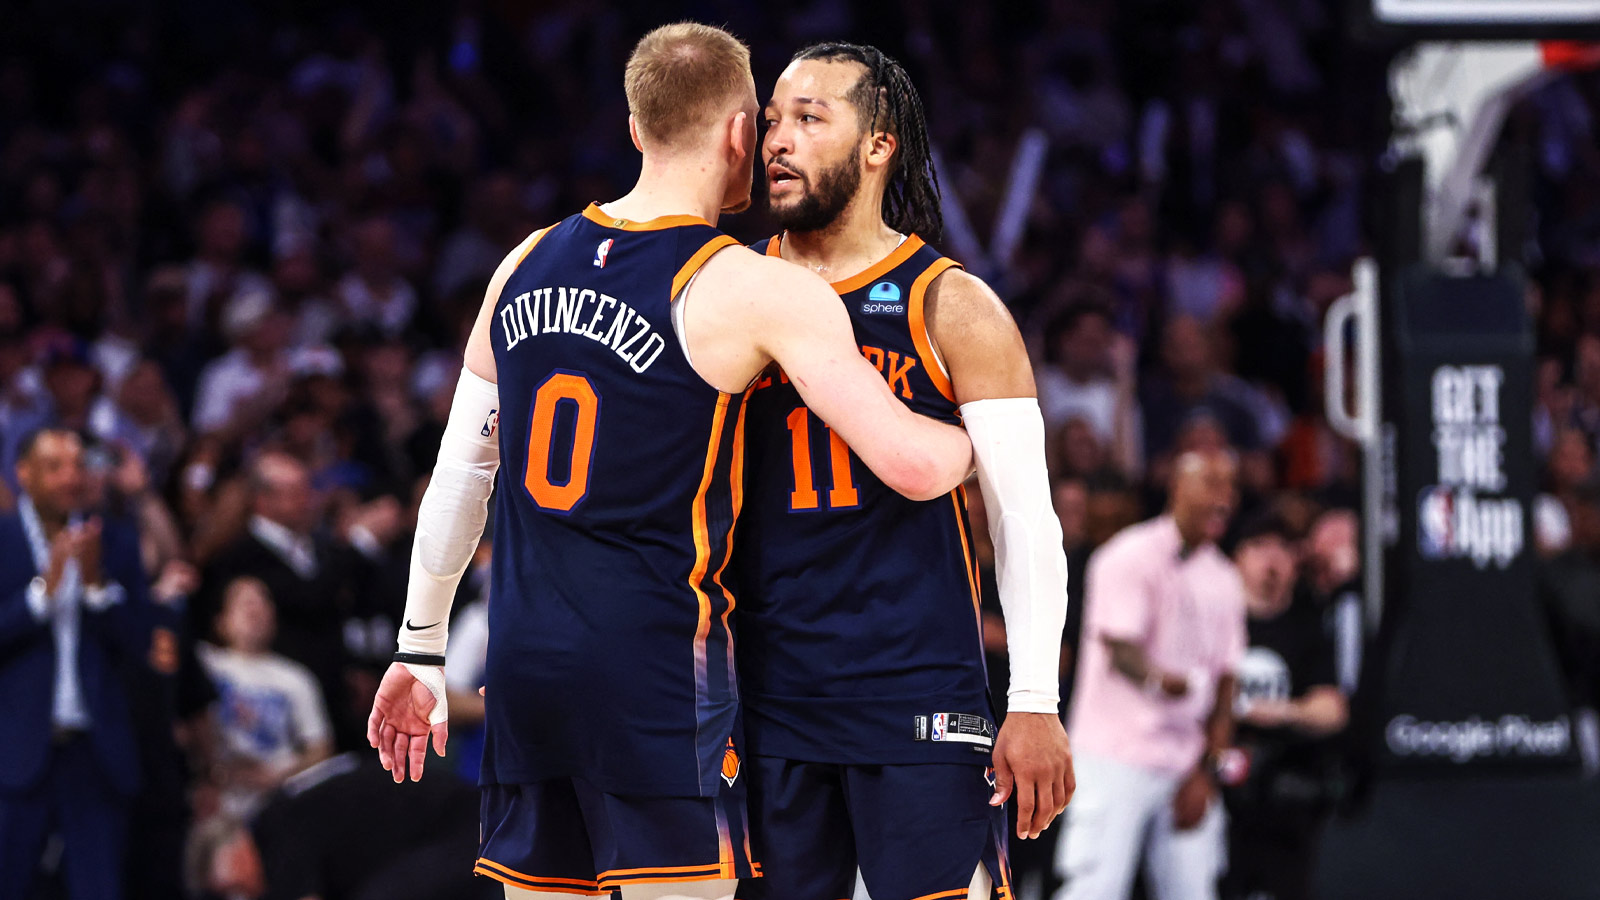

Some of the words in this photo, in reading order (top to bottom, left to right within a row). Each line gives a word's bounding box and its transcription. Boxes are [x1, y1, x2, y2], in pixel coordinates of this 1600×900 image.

[500, 286, 666, 374] DIVINCENZO
[863, 303, 903, 314] sphere
[860, 345, 916, 400] RK
[1432, 365, 1503, 424] GET
[522, 370, 600, 514] 0
[786, 406, 860, 511] 11
[1433, 424, 1506, 491] THE
[1385, 714, 1497, 763] Google
[1499, 714, 1571, 757] Pixel
